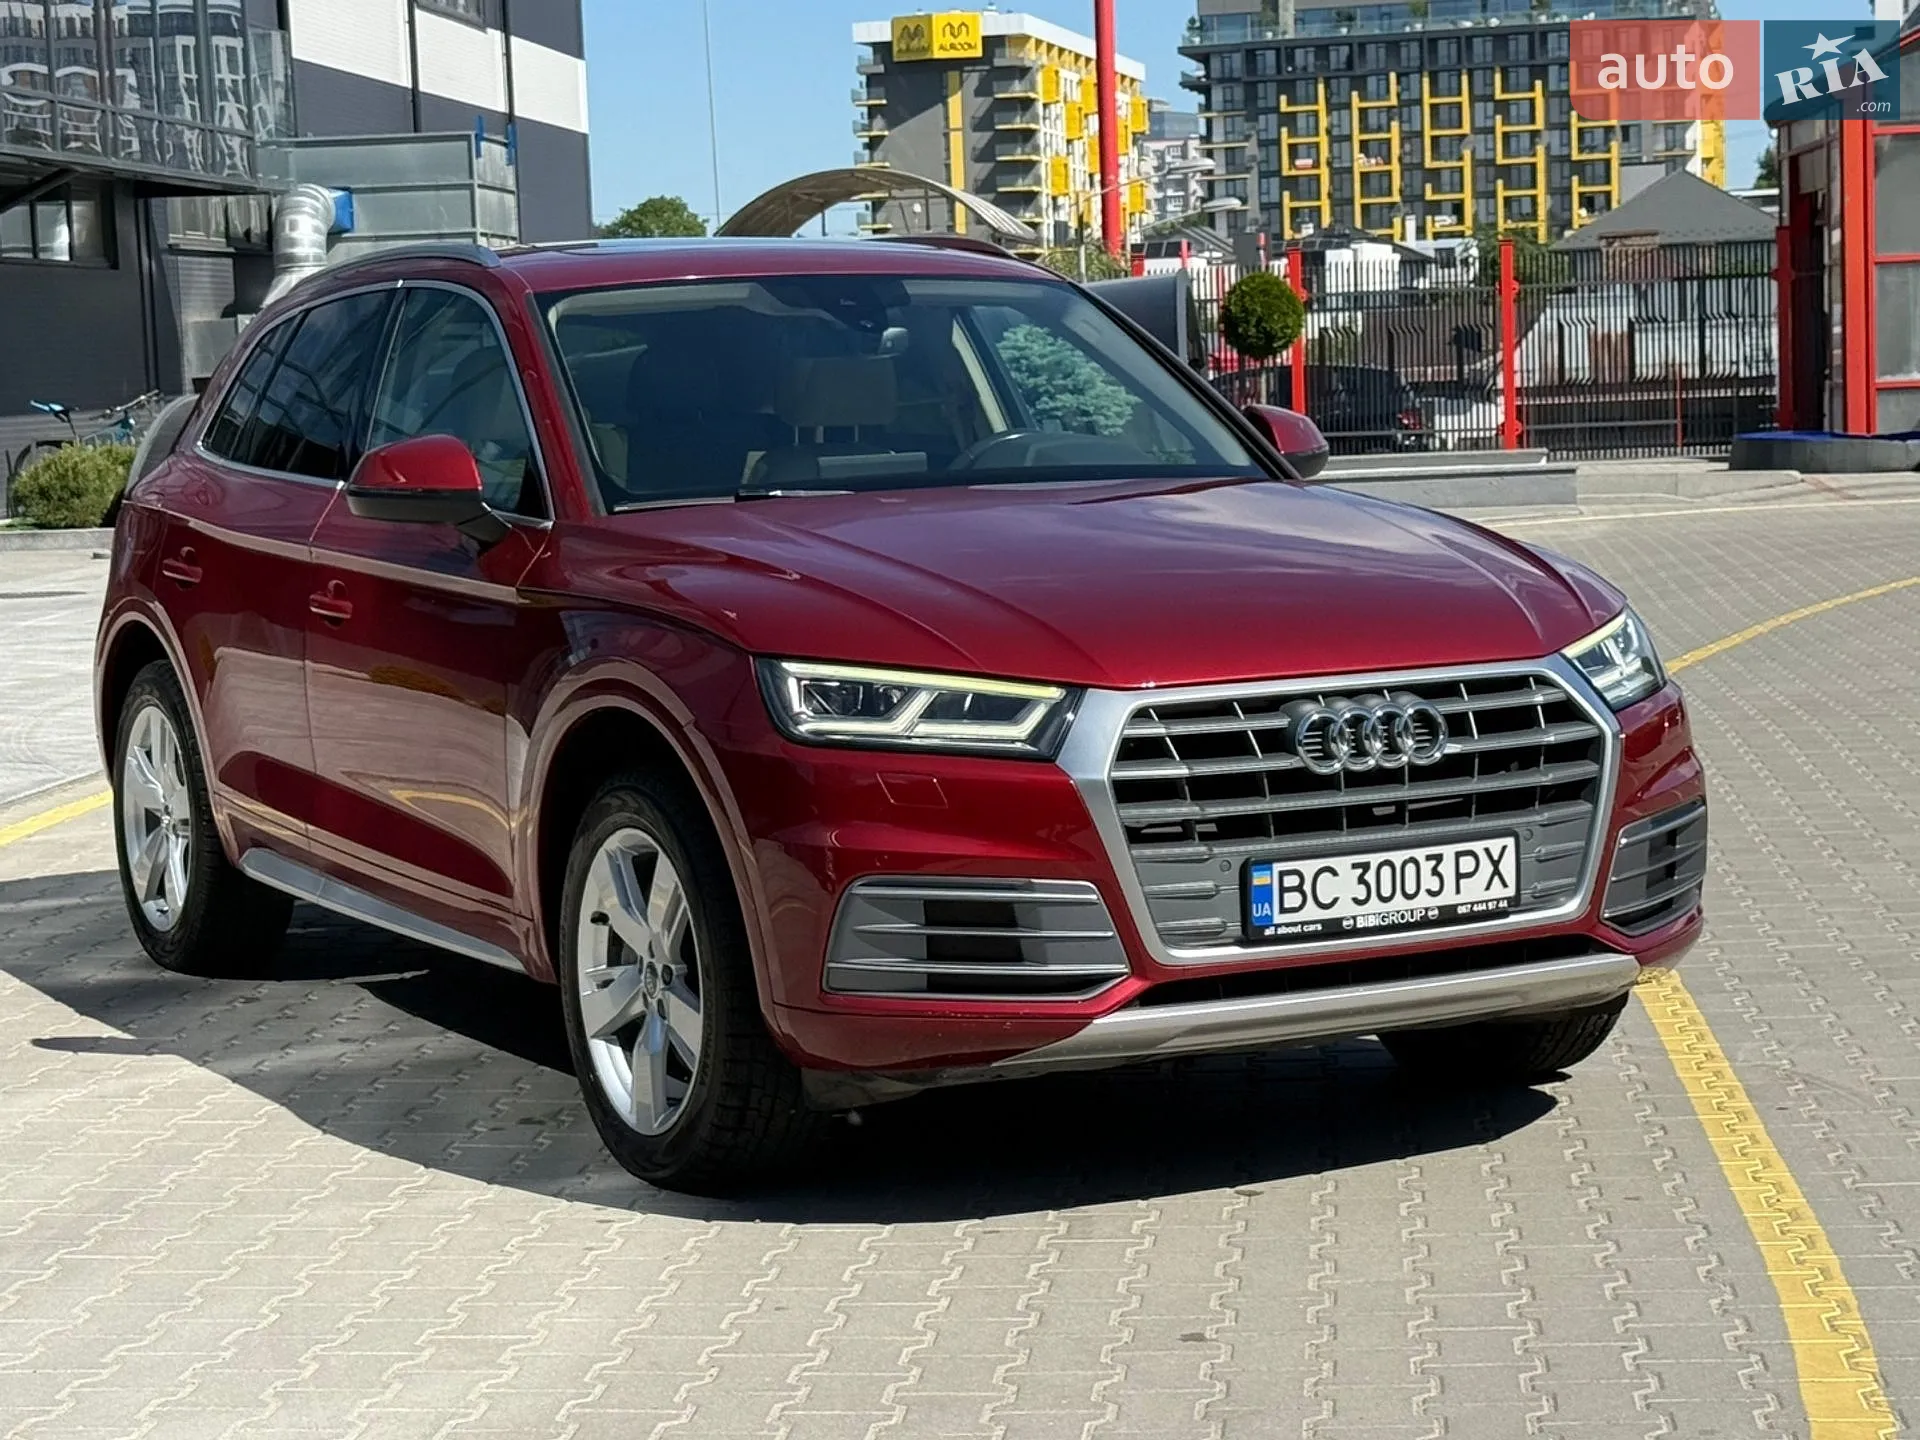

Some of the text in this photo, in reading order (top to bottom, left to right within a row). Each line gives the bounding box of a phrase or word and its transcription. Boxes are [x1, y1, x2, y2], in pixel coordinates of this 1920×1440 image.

[1278, 845, 1509, 915] BC 3003 PX
[1253, 904, 1271, 917] UA
[1264, 923, 1322, 936] all about cars
